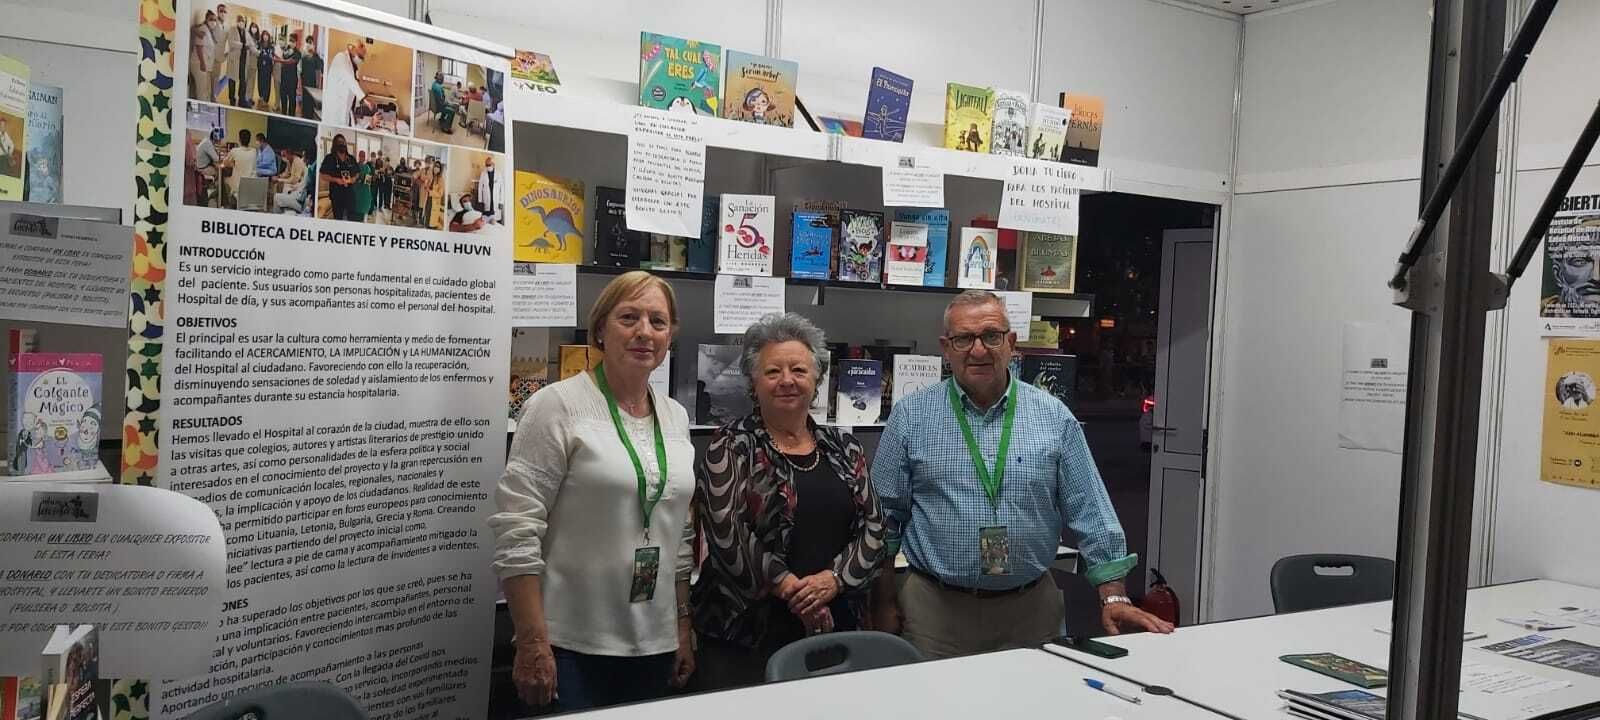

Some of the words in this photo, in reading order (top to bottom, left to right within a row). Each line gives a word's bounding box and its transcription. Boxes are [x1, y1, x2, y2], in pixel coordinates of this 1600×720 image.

[667, 64, 695, 80] ERES
[956, 90, 988, 115] LIGHTFALL
[1561, 196, 1600, 210] BIERT
[201, 220, 285, 239] BIBLIOTECA
[289, 228, 313, 240] DEL
[317, 231, 375, 246] PACIENTE
[379, 236, 387, 246] Y
[390, 237, 449, 252] PERSONAL
[453, 243, 490, 255] HUVN
[737, 213, 761, 248] 5
[179, 246, 264, 260] INTRODUCCIÓN
[178, 261, 191, 271] Es
[193, 264, 207, 272] un
[210, 264, 251, 274] servicio
[253, 265, 300, 278] integrado
[303, 270, 329, 278] como
[331, 272, 354, 280] parte
[356, 271, 411, 283] fundamental
[424, 276, 430, 284] el
[432, 277, 467, 286] cuidado
[469, 279, 495, 289] global
[178, 278, 195, 287] del
[201, 279, 249, 290] paciente.
[252, 281, 269, 290] Sus
[272, 282, 312, 292] usuarios
[314, 285, 330, 293] son
[333, 286, 371, 296] personas
[373, 286, 432, 298] hospitalizadas,
[434, 290, 477, 300] pacientes
[479, 292, 490, 300] de
[177, 293, 222, 305] Hospital
[224, 295, 238, 304] de
[240, 295, 259, 307] día,
[262, 298, 267, 307] y
[288, 298, 355, 309] acompañantes
[356, 299, 368, 308] así
[397, 300, 405, 309] el
[407, 302, 439, 311] personal
[441, 302, 455, 311] del
[457, 303, 495, 314] hospital.
[176, 316, 236, 327] OBJETIVOS
[176, 333, 185, 342] El
[188, 333, 235, 344] principal
[237, 335, 249, 343] es
[275, 333, 284, 342] la
[286, 333, 319, 342] cultura
[322, 335, 347, 343] como
[349, 333, 402, 345] herramienta
[404, 337, 409, 345] y
[411, 334, 433, 343] medio
[435, 334, 446, 343] de
[448, 334, 490, 347] fomentar
[175, 347, 231, 358] facilitando
[234, 347, 243, 357] el
[246, 348, 326, 357] ACERCAMIENTO,
[329, 348, 340, 356] LA
[343, 347, 400, 356] IMPLICACIÓN
[402, 350, 407, 358] y
[410, 348, 419, 356] LA
[420, 347, 490, 357] HUMANIZACIÓN
[173, 393, 251, 405] acompañantes
[253, 392, 292, 401] durante
[308, 389, 344, 399] estancia
[347, 387, 399, 398] hospitalaria.
[171, 434, 209, 444] Hemos
[212, 430, 250, 441] llevado
[252, 429, 261, 439] el
[264, 426, 303, 439] Hospital
[305, 426, 314, 435] al
[316, 423, 350, 434] corazón
[352, 423, 362, 431] de
[364, 422, 372, 430] la
[374, 420, 406, 430] ciudad,
[408, 419, 438, 428] muestra
[440, 417, 451, 425] de
[454, 417, 471, 425] ello
[172, 415, 242, 428] RESULTADOS
[161, 680, 210, 699] actividad
[212, 665, 274, 688] hospitalaria.
